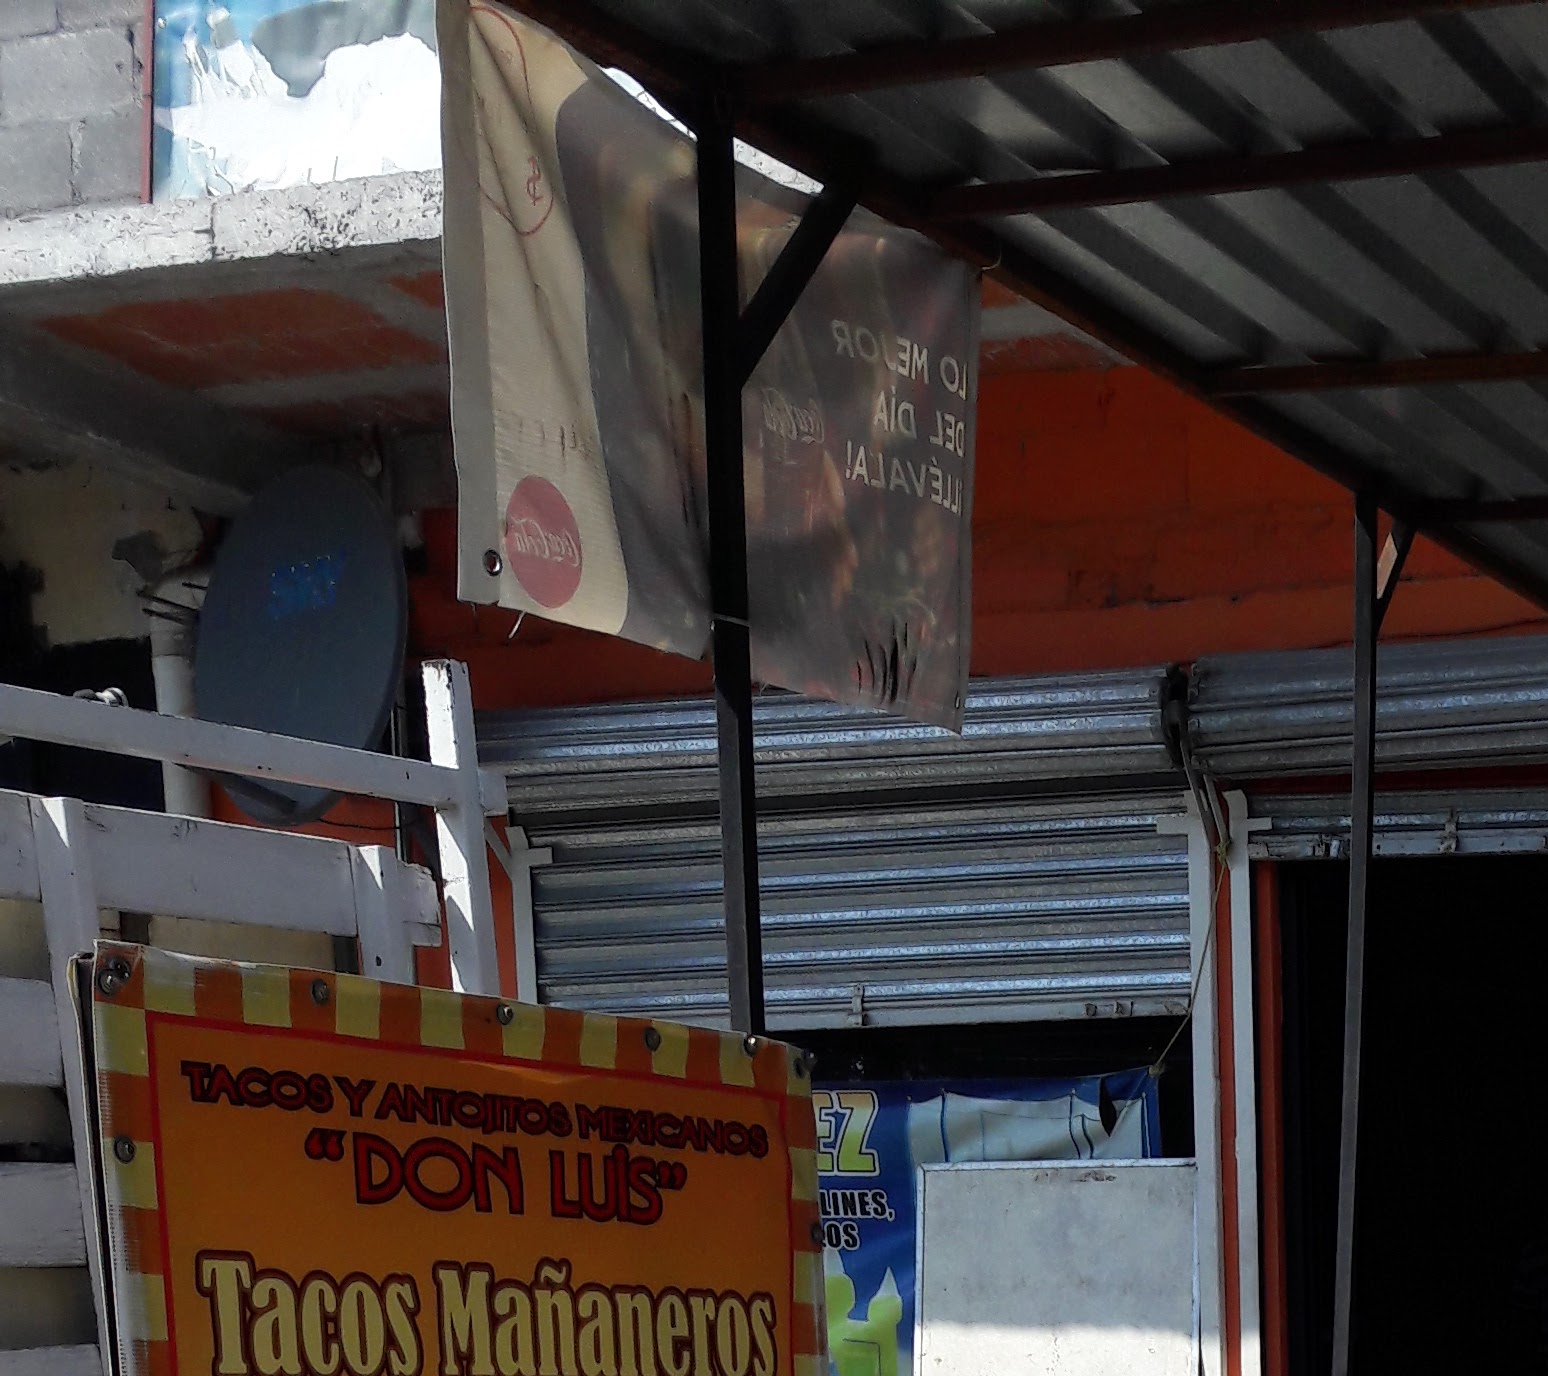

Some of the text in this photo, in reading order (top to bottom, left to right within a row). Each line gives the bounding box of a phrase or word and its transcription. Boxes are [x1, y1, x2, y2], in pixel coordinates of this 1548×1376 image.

[180, 1059, 770, 1159] TACOS Y ANTOJITOS MEXICANOS
[822, 1221, 860, 1250] OS
